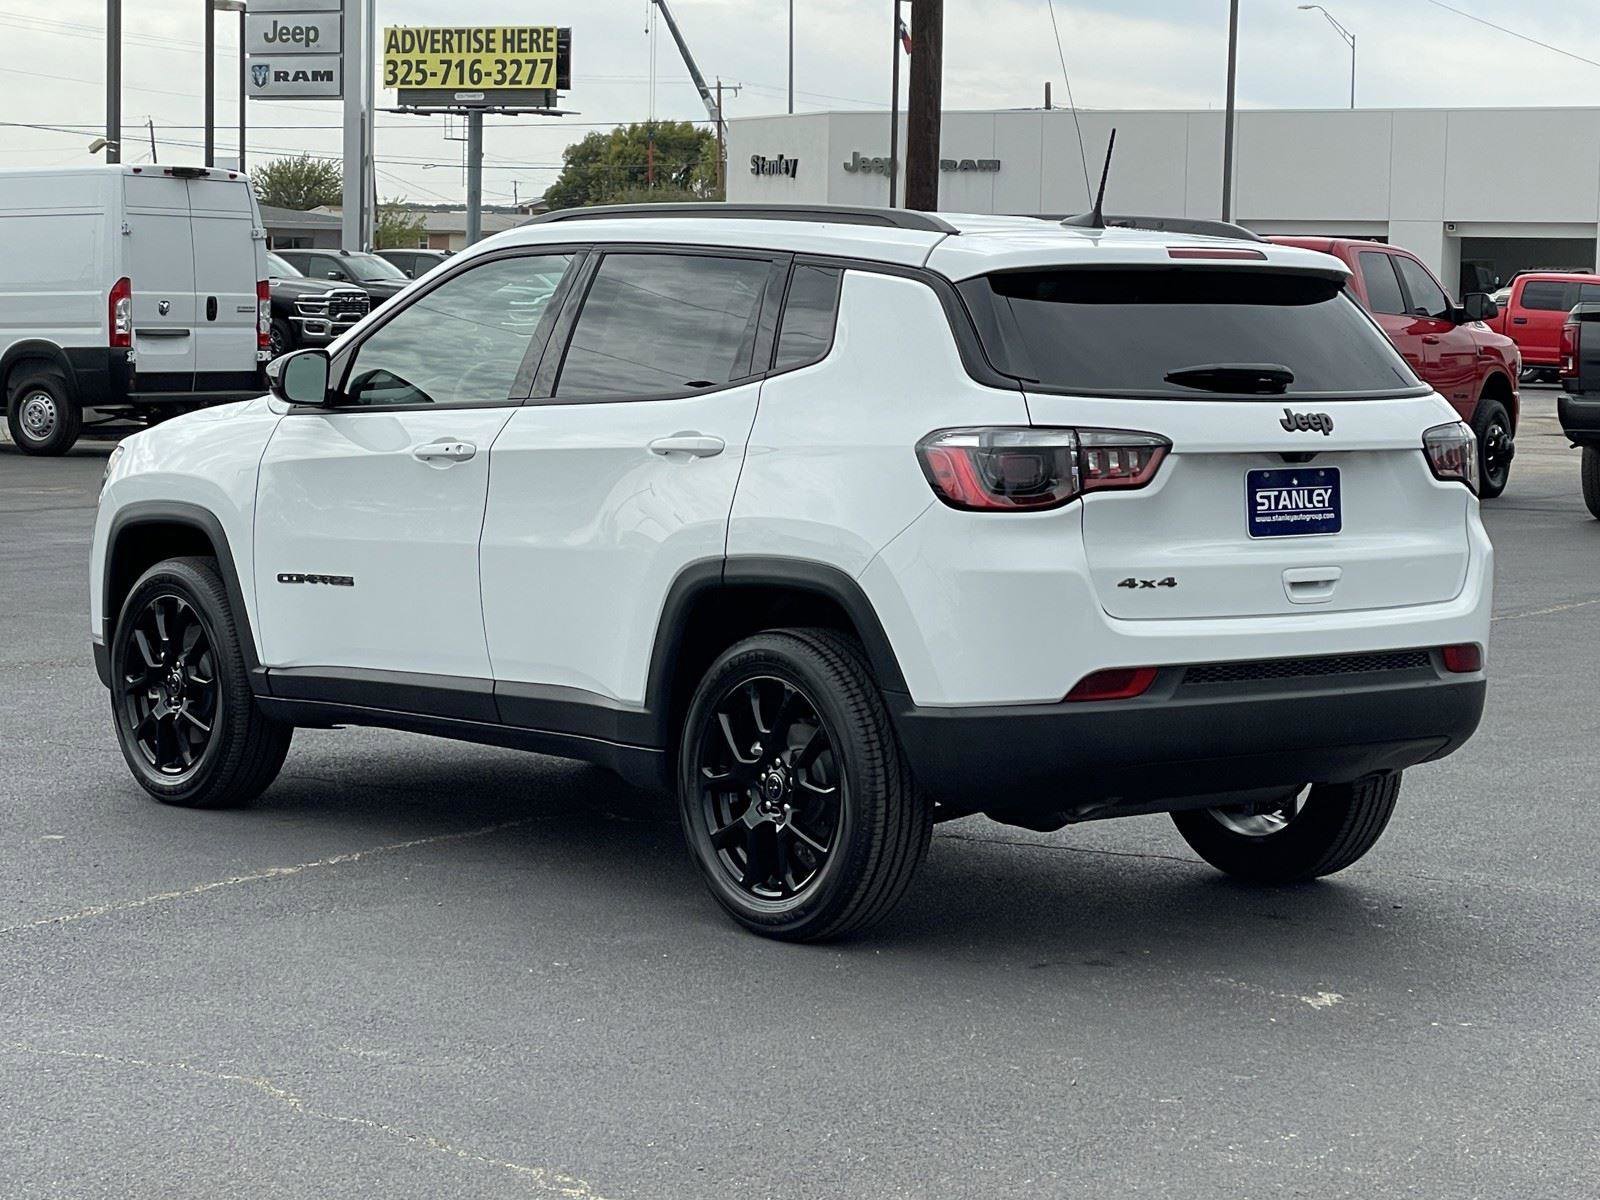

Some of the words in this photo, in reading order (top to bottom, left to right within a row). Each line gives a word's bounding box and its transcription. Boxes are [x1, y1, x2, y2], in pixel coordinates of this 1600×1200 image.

[264, 20, 320, 48] Jeep
[386, 28, 496, 54] ADVERTISE
[502, 27, 554, 53] HERE
[274, 70, 334, 82] RAM
[385, 59, 554, 86] 325-716-3277
[750, 154, 799, 178] Stanley
[940, 159, 1000, 172] RAM
[1279, 408, 1334, 436] Jeep
[1256, 489, 1332, 510] STANLEY
[1255, 513, 1335, 522] www.stanleyautogroup.com
[1117, 577, 1177, 588] 4x4
